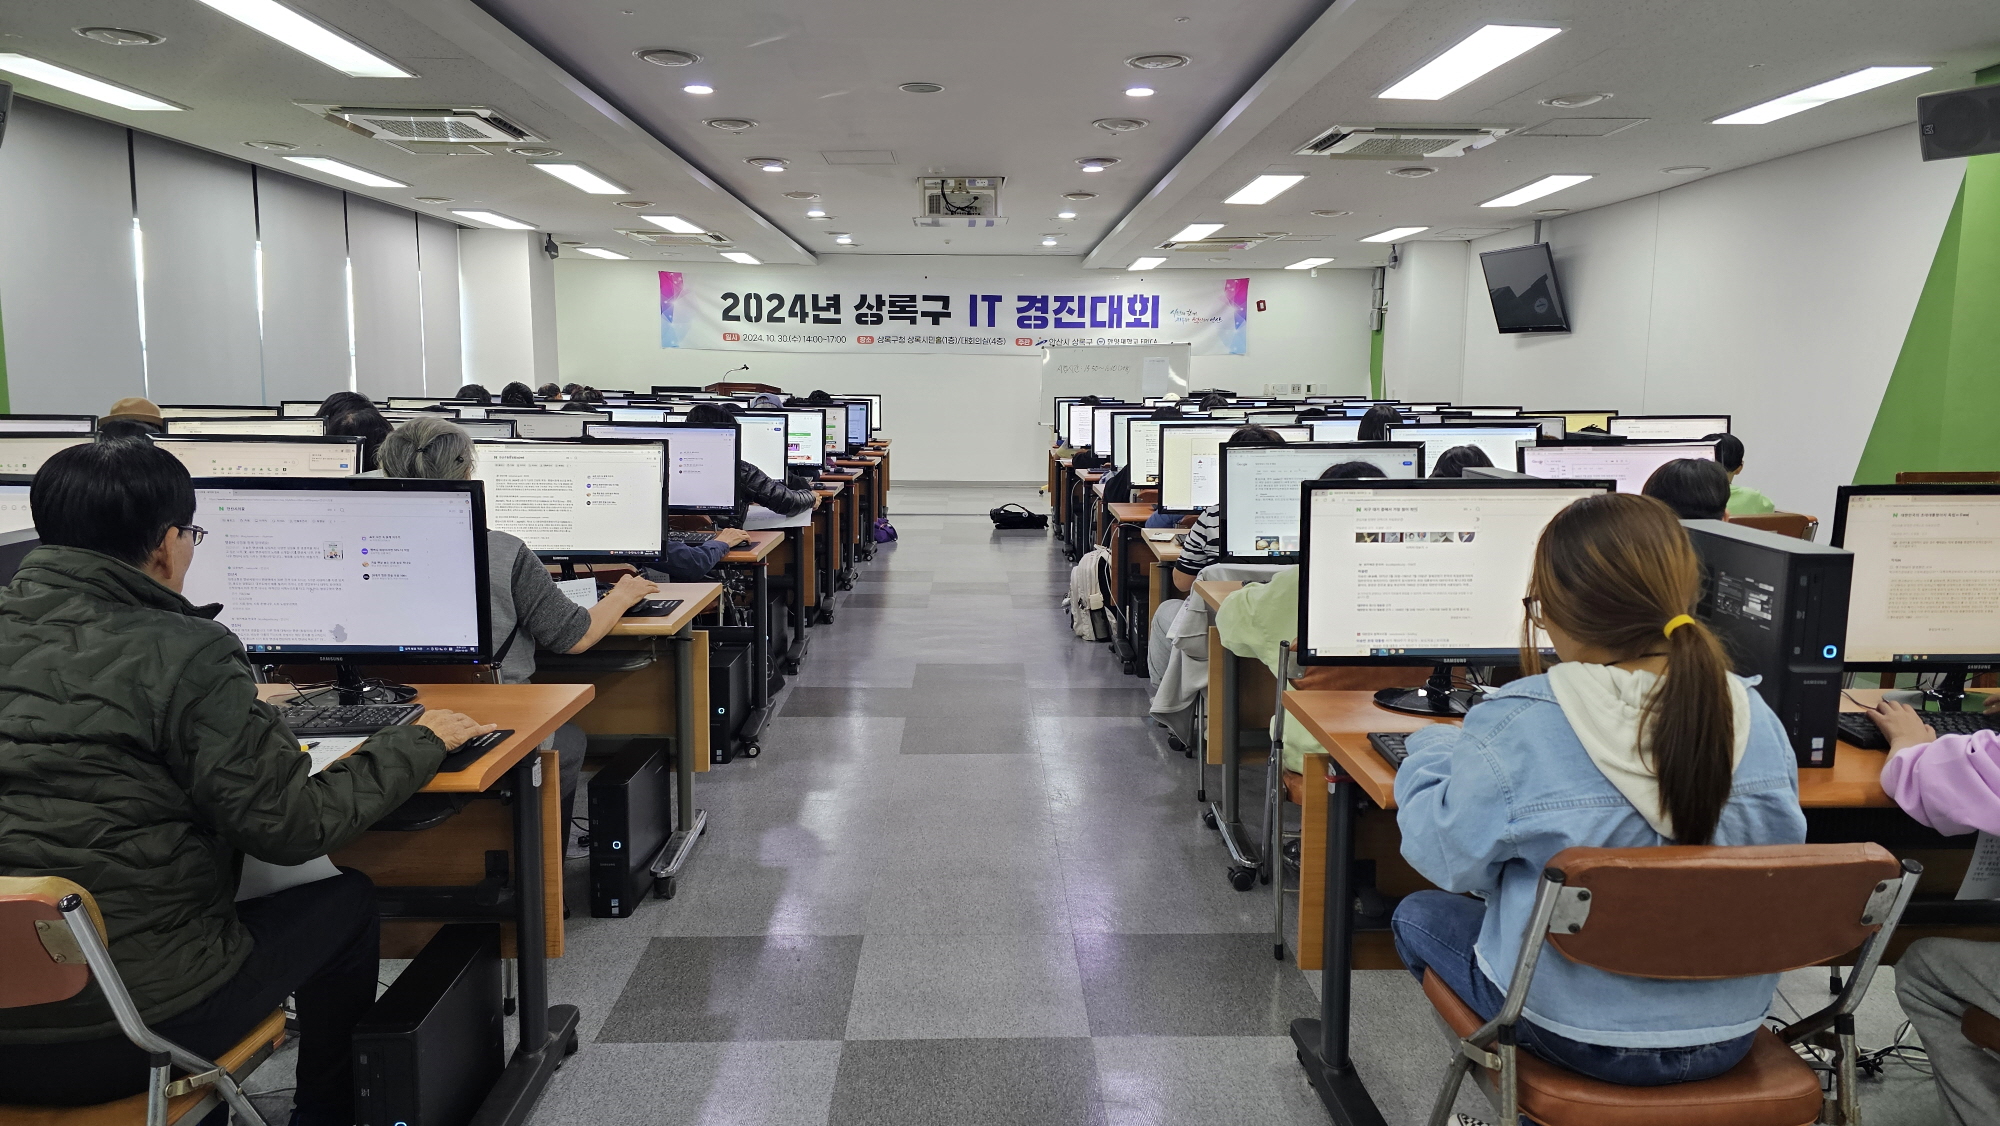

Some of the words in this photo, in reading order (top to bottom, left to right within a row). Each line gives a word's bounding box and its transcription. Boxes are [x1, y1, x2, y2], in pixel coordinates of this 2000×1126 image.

[720, 292, 841, 325] 2024년
[853, 293, 951, 326] 상록구
[969, 294, 1003, 328] IT
[1015, 293, 1160, 329] 경진대회
[725, 333, 738, 341] 일시
[742, 333, 764, 342] 2024.
[859, 336, 872, 344] 장소
[877, 336, 906, 344] 상록구청
[1048, 338, 1070, 346] 안산시
[1072, 338, 1093, 346] 상록구
